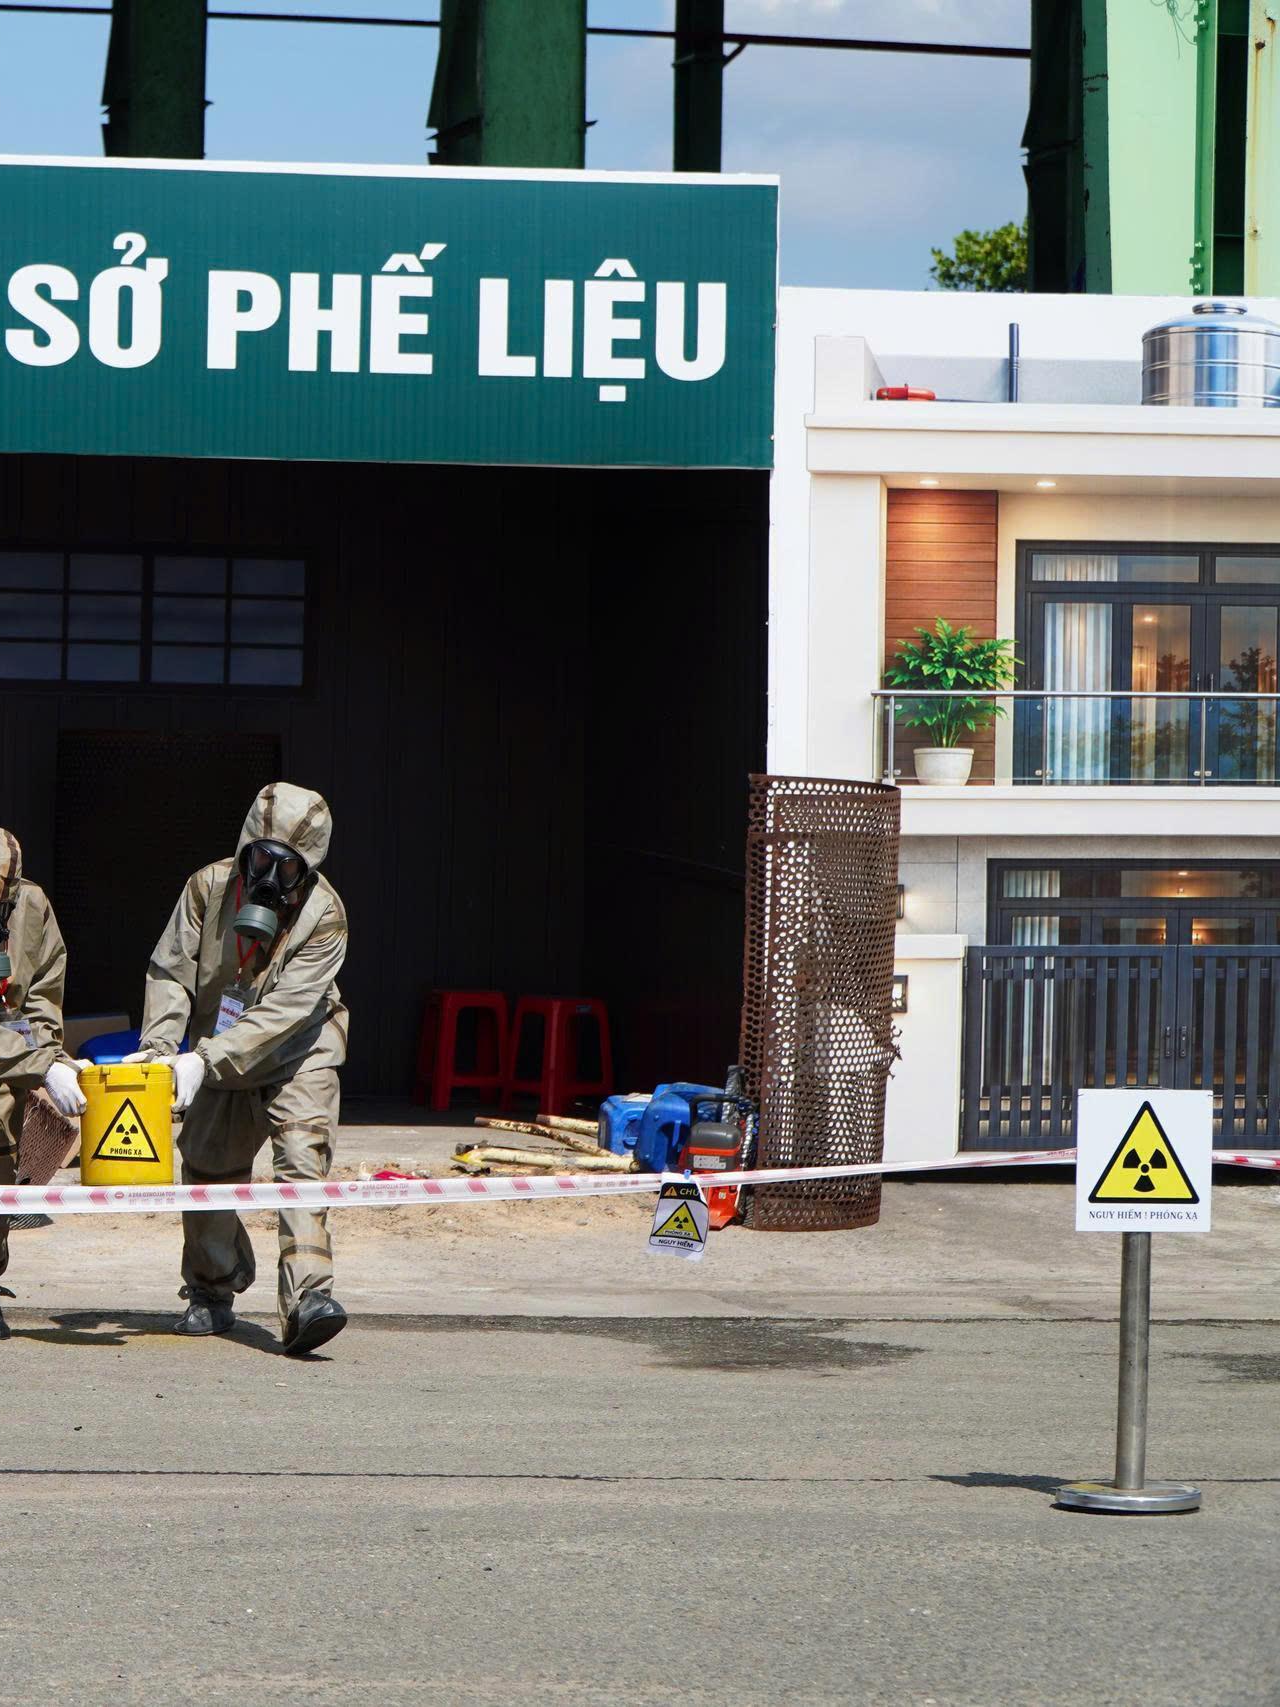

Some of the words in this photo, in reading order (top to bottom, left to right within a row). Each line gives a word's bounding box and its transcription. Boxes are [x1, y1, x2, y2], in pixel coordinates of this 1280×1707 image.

[5, 232, 168, 368] SỞ
[207, 243, 446, 374] PHẾ
[478, 259, 726, 402] LIỆU
[1089, 1210, 1115, 1219] NGUY
